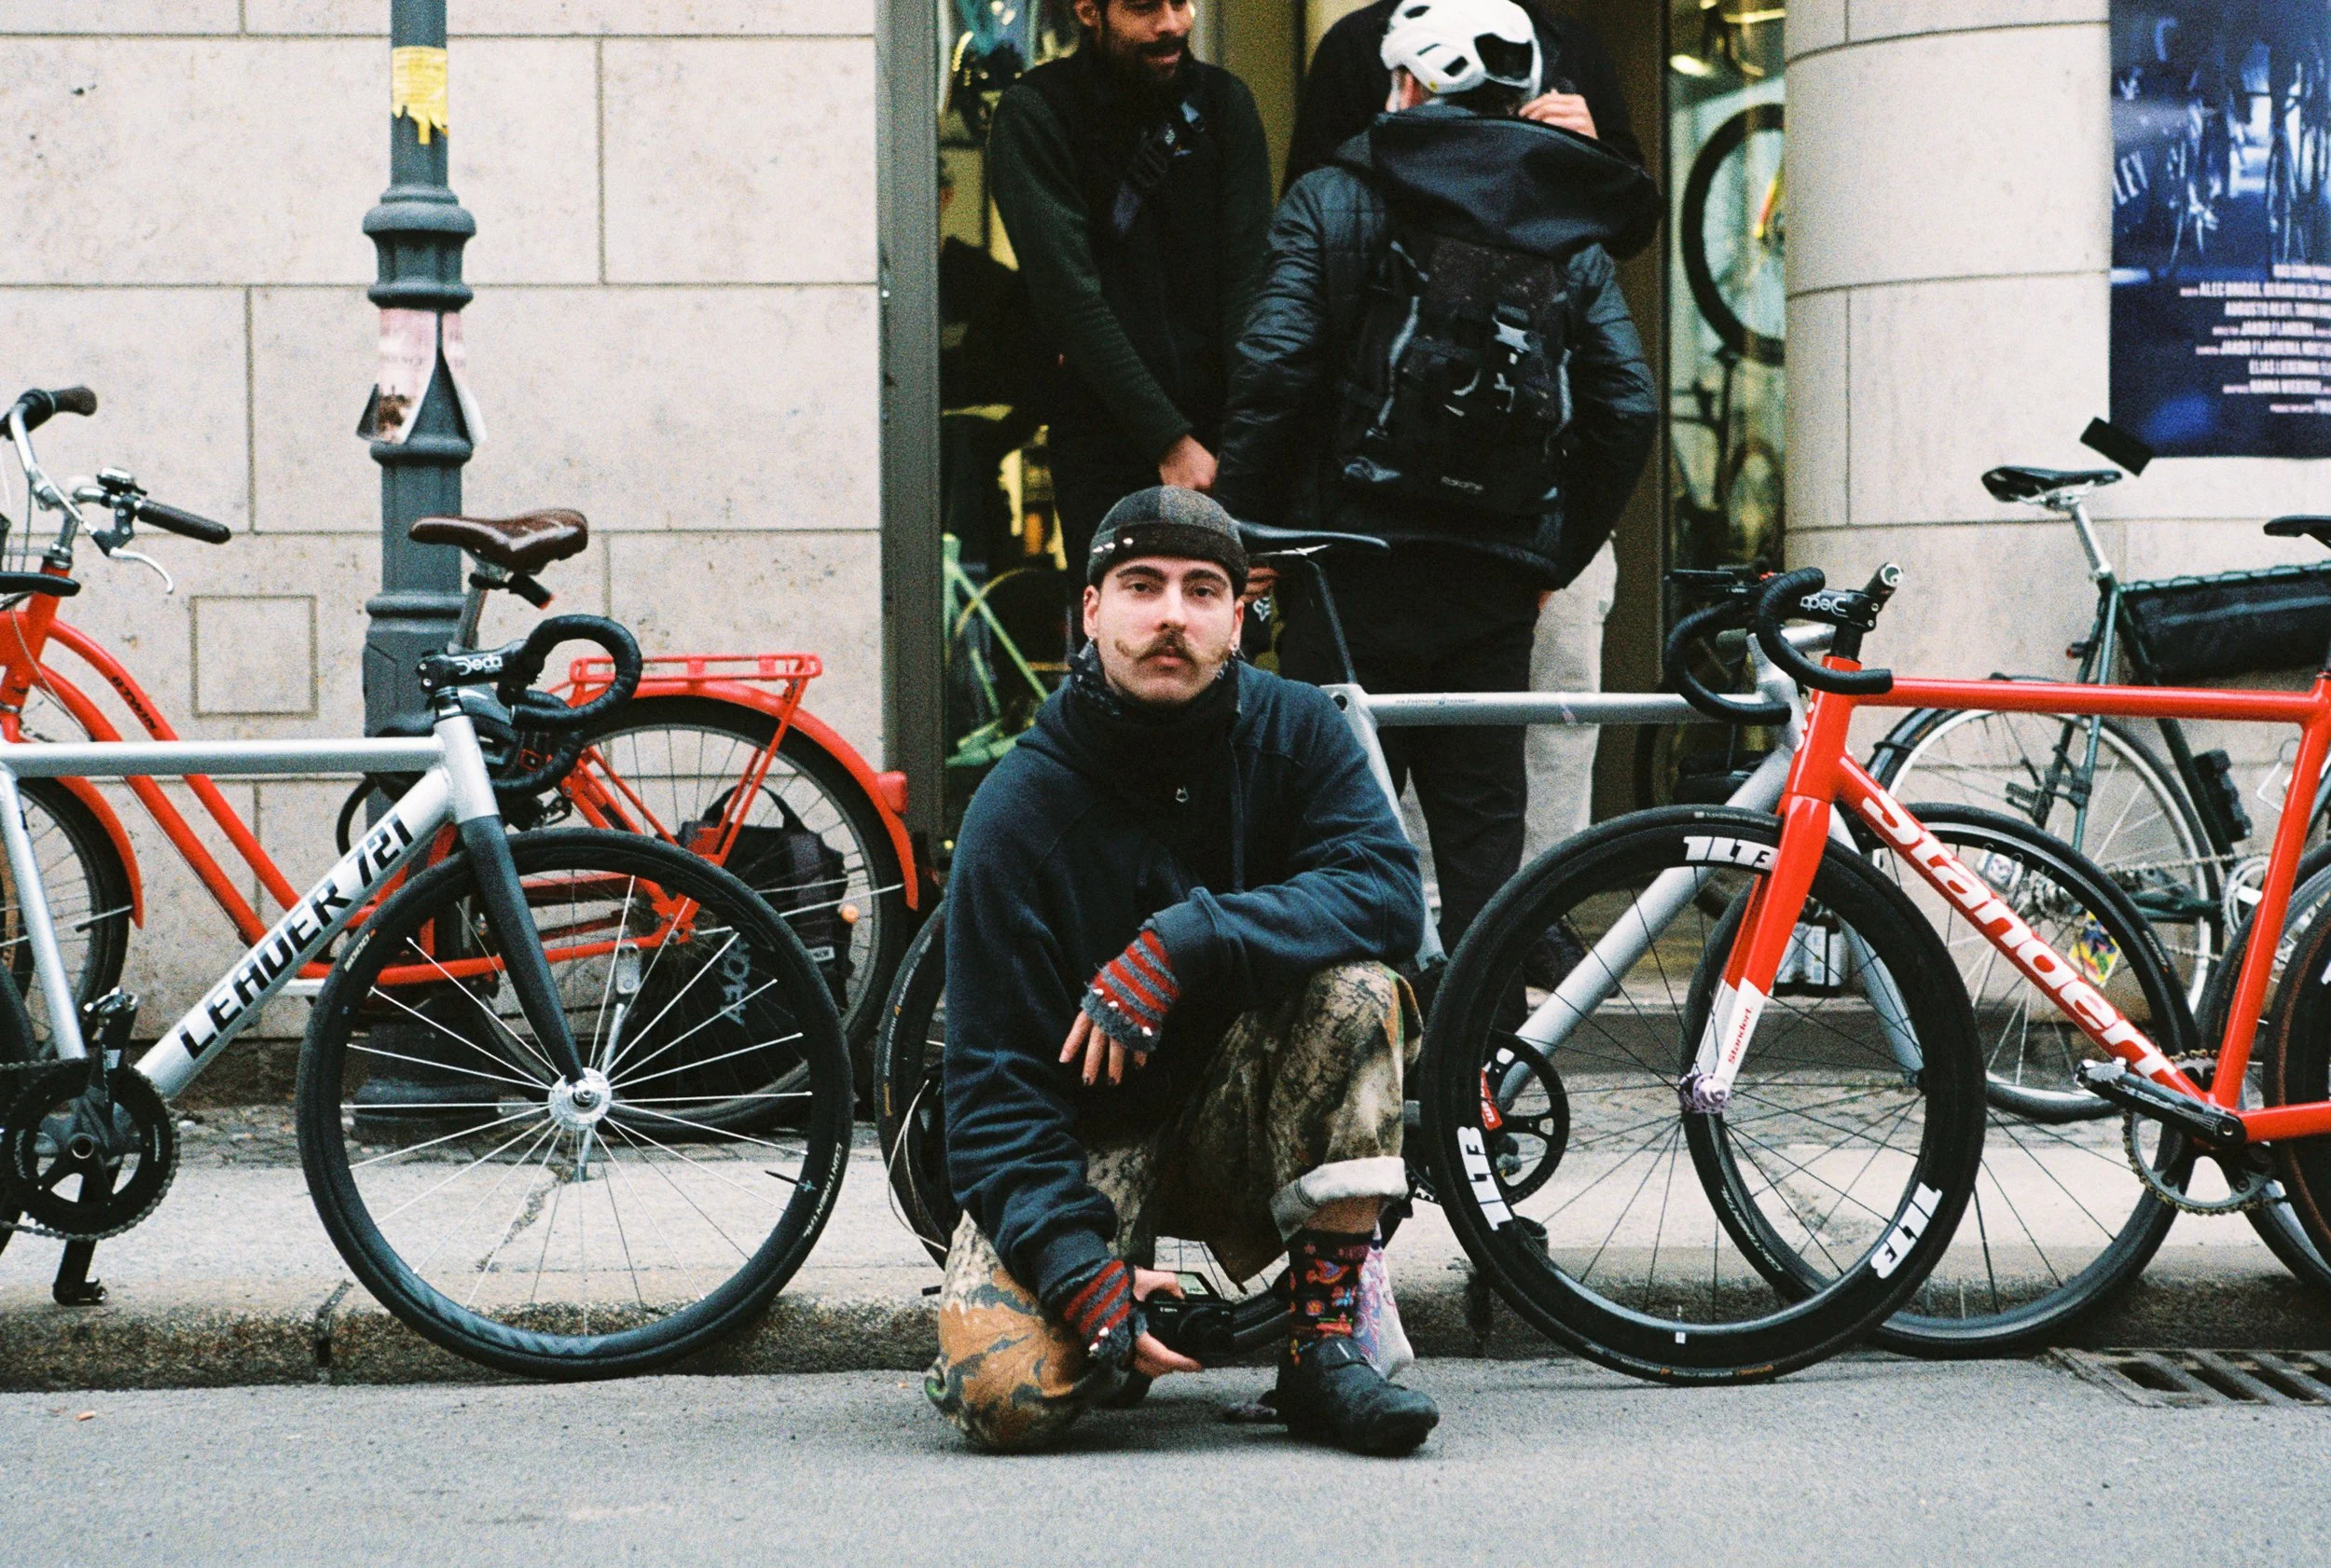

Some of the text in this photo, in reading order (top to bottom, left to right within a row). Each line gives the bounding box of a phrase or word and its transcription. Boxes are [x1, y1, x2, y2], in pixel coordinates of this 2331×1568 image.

[177, 811, 414, 1060] LEADER 721
[803, 1142, 843, 1238] CONTINENTAL
[1721, 1186, 1784, 1272] CONTINENTAL
